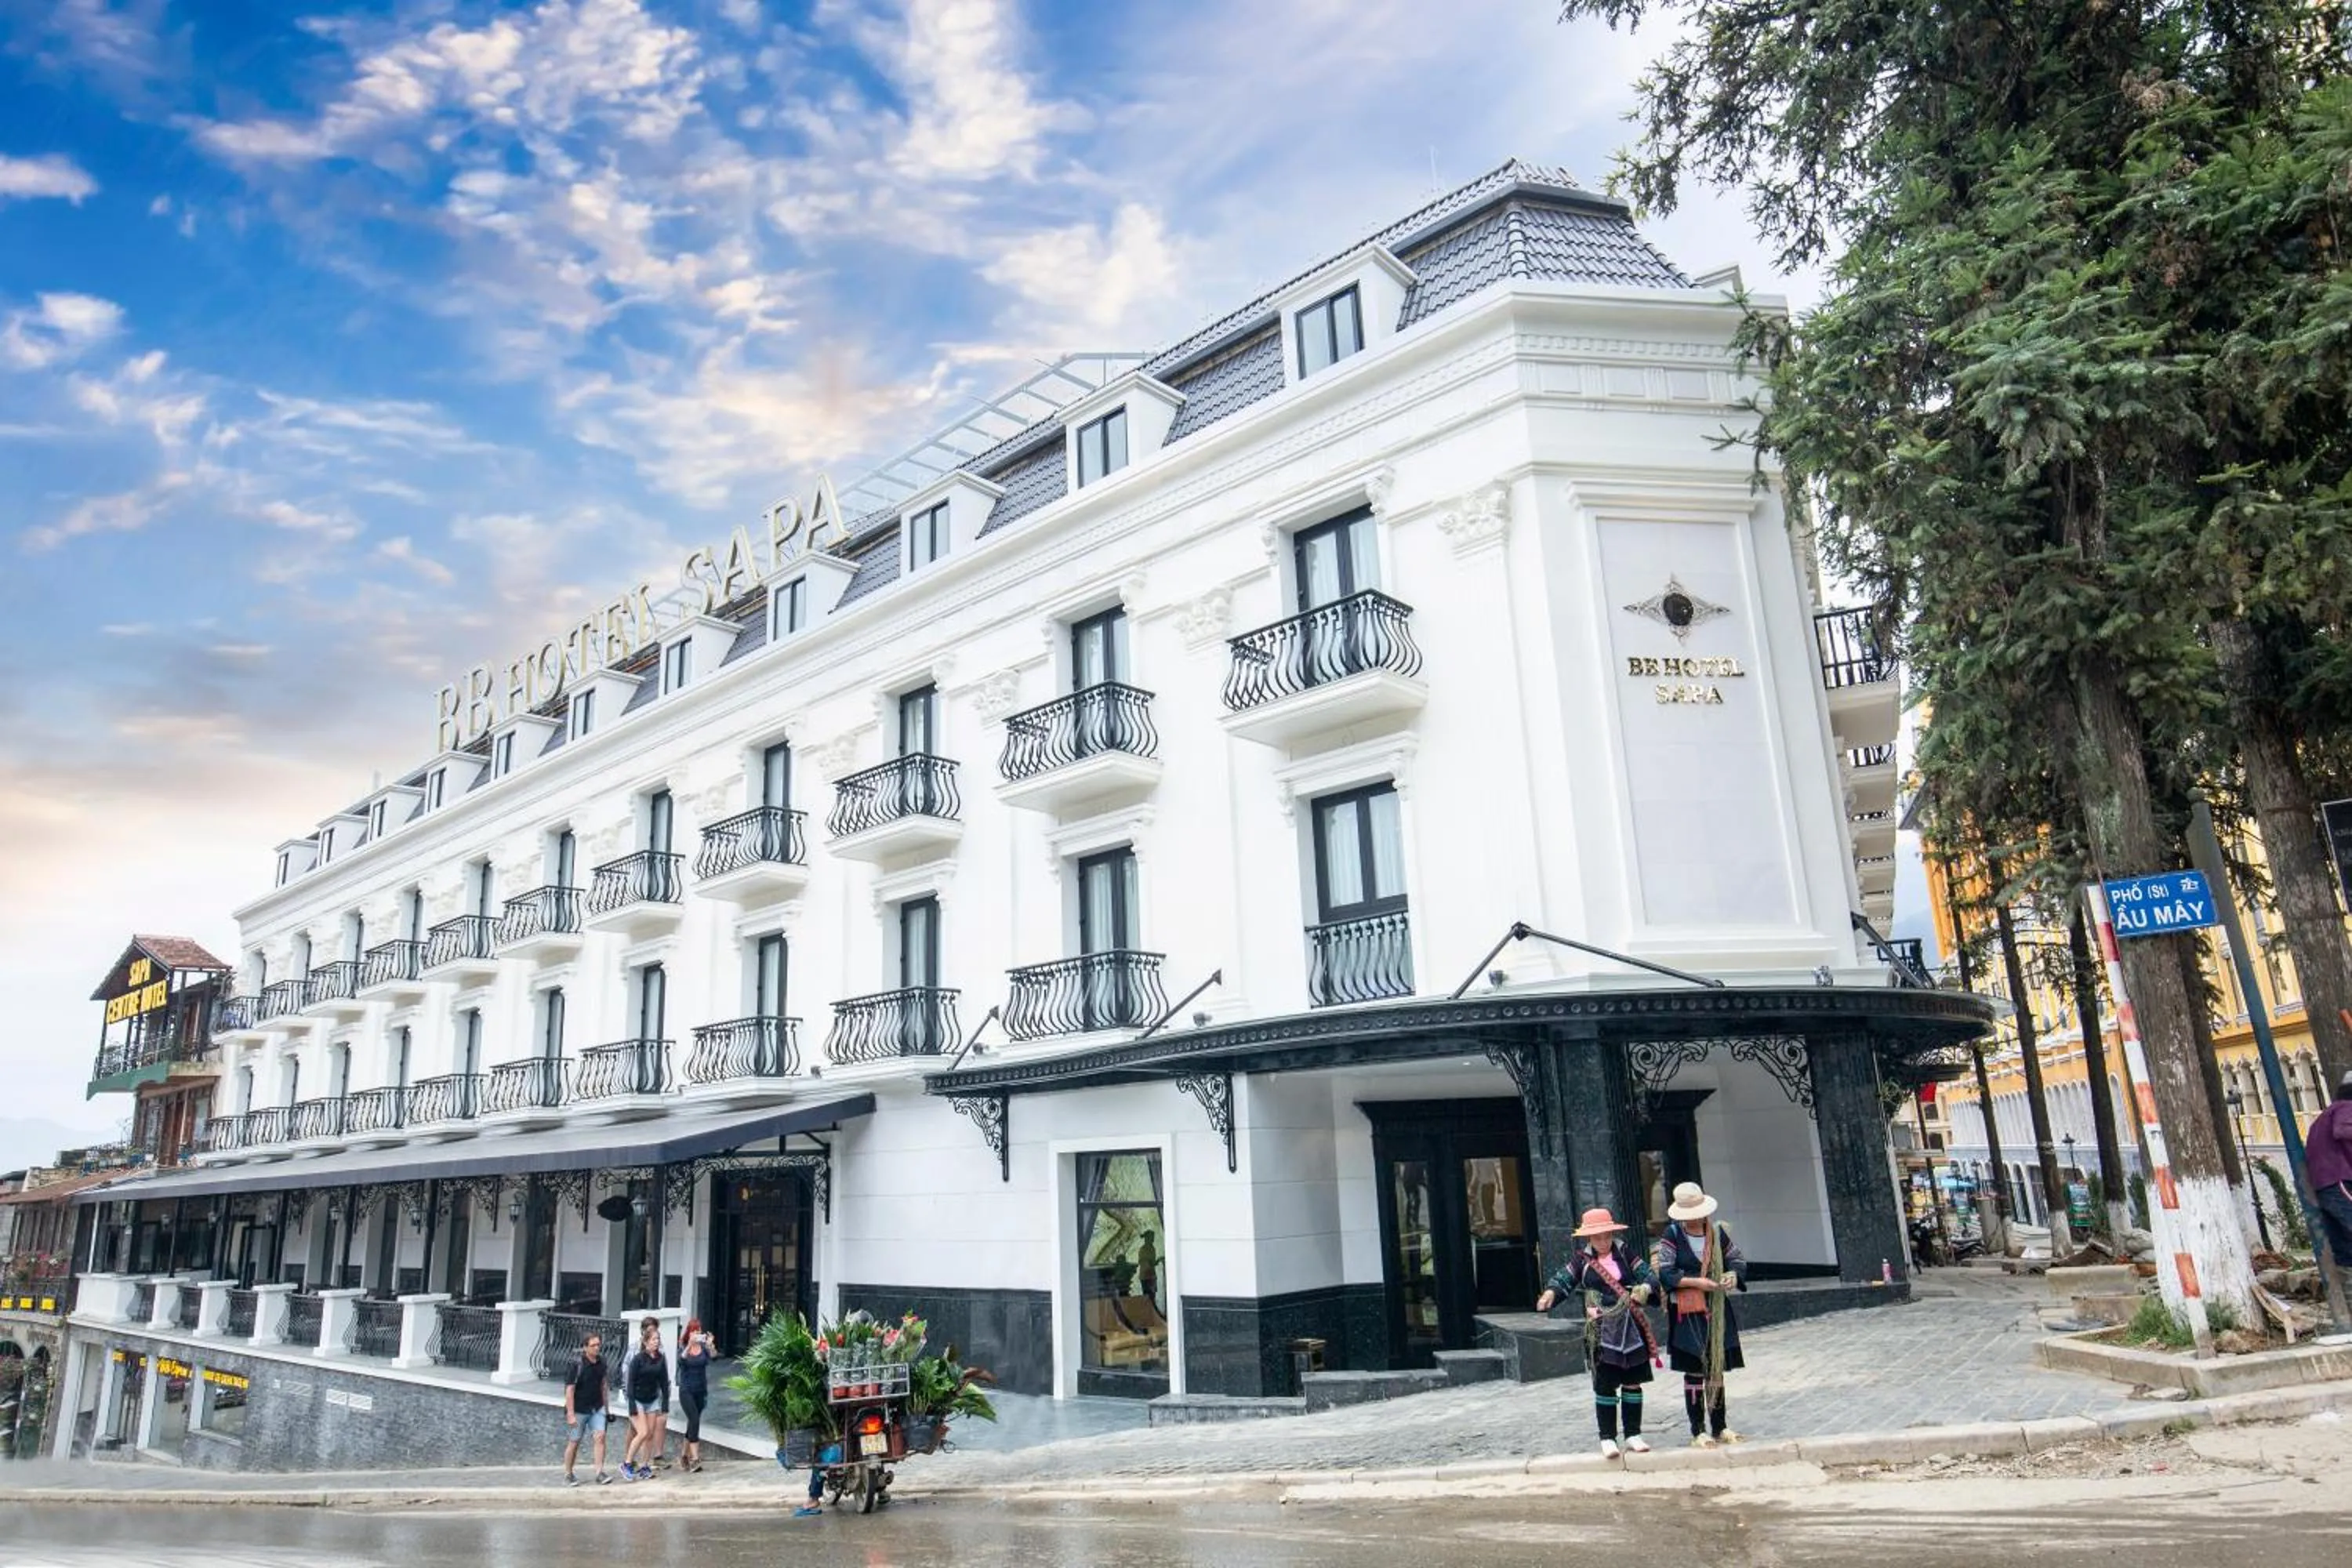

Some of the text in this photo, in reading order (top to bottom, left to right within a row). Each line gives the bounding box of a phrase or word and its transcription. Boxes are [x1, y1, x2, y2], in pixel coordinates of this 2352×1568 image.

[680, 473, 852, 615] SAPA
[1661, 656, 1744, 678] HOTEL
[1655, 683, 1724, 704] SAPA
[2111, 882, 2143, 903] PHỐ
[2111, 899, 2204, 930] ẦU MÂY
